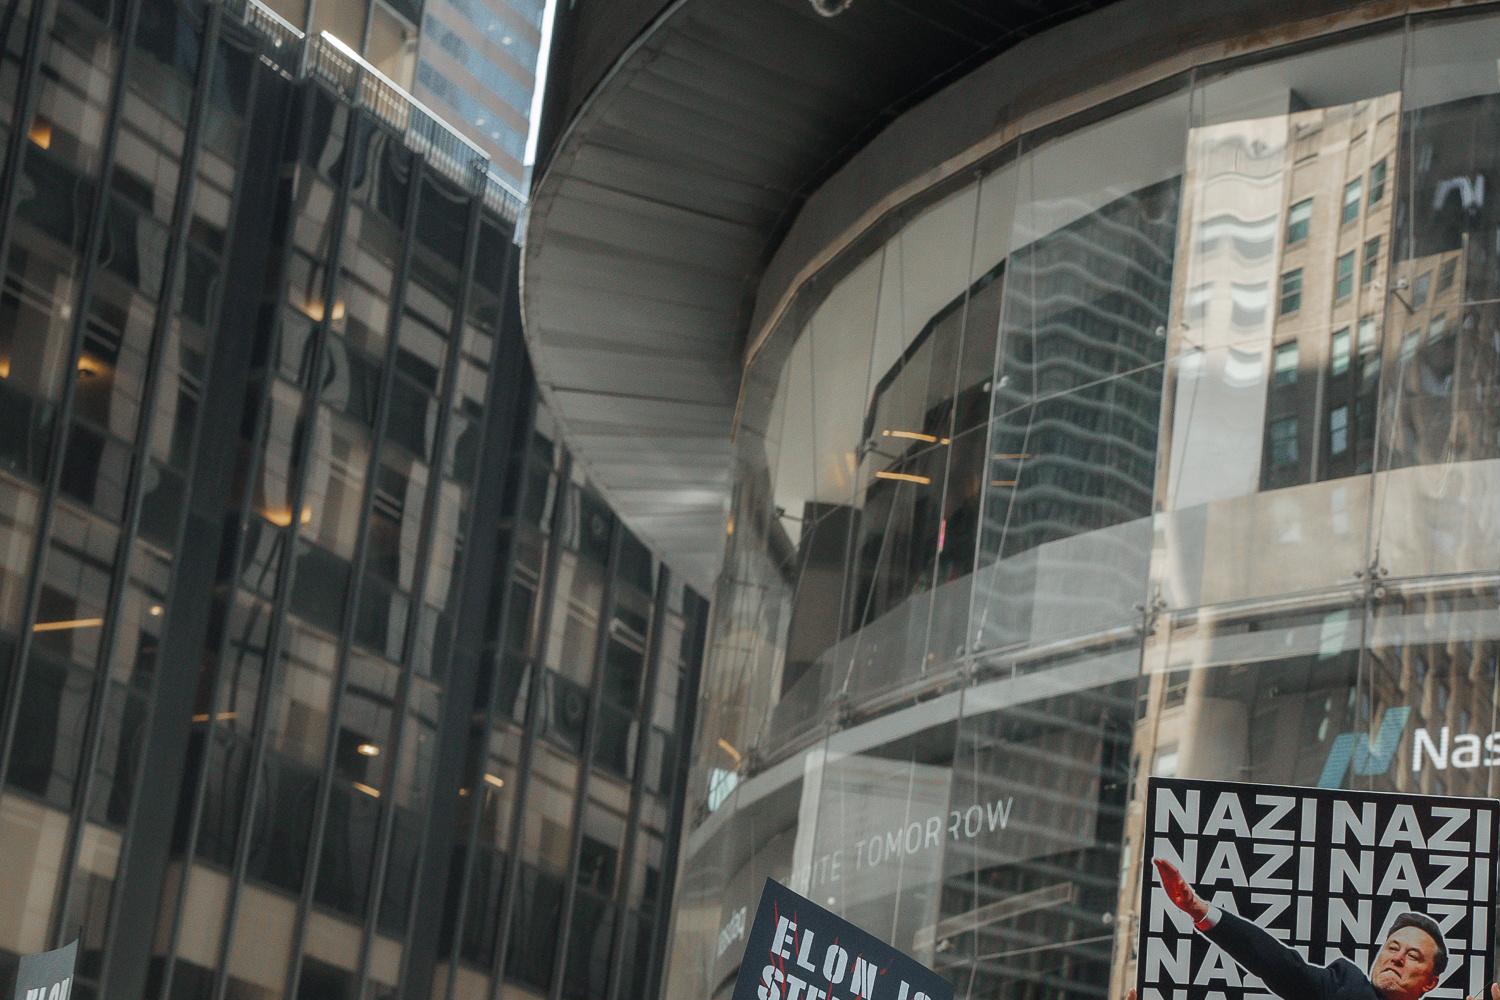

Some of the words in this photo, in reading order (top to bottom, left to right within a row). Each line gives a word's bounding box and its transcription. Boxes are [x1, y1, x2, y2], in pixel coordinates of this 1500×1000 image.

[855, 797, 1013, 871] TOMORROW
[1154, 787, 1317, 843] NAZI
[1332, 800, 1492, 853] NAZI
[1152, 837, 1315, 891] NAZI
[1329, 847, 1490, 902] NAZI
[771, 916, 878, 1000] ELON
[1145, 937, 1309, 989] NA
